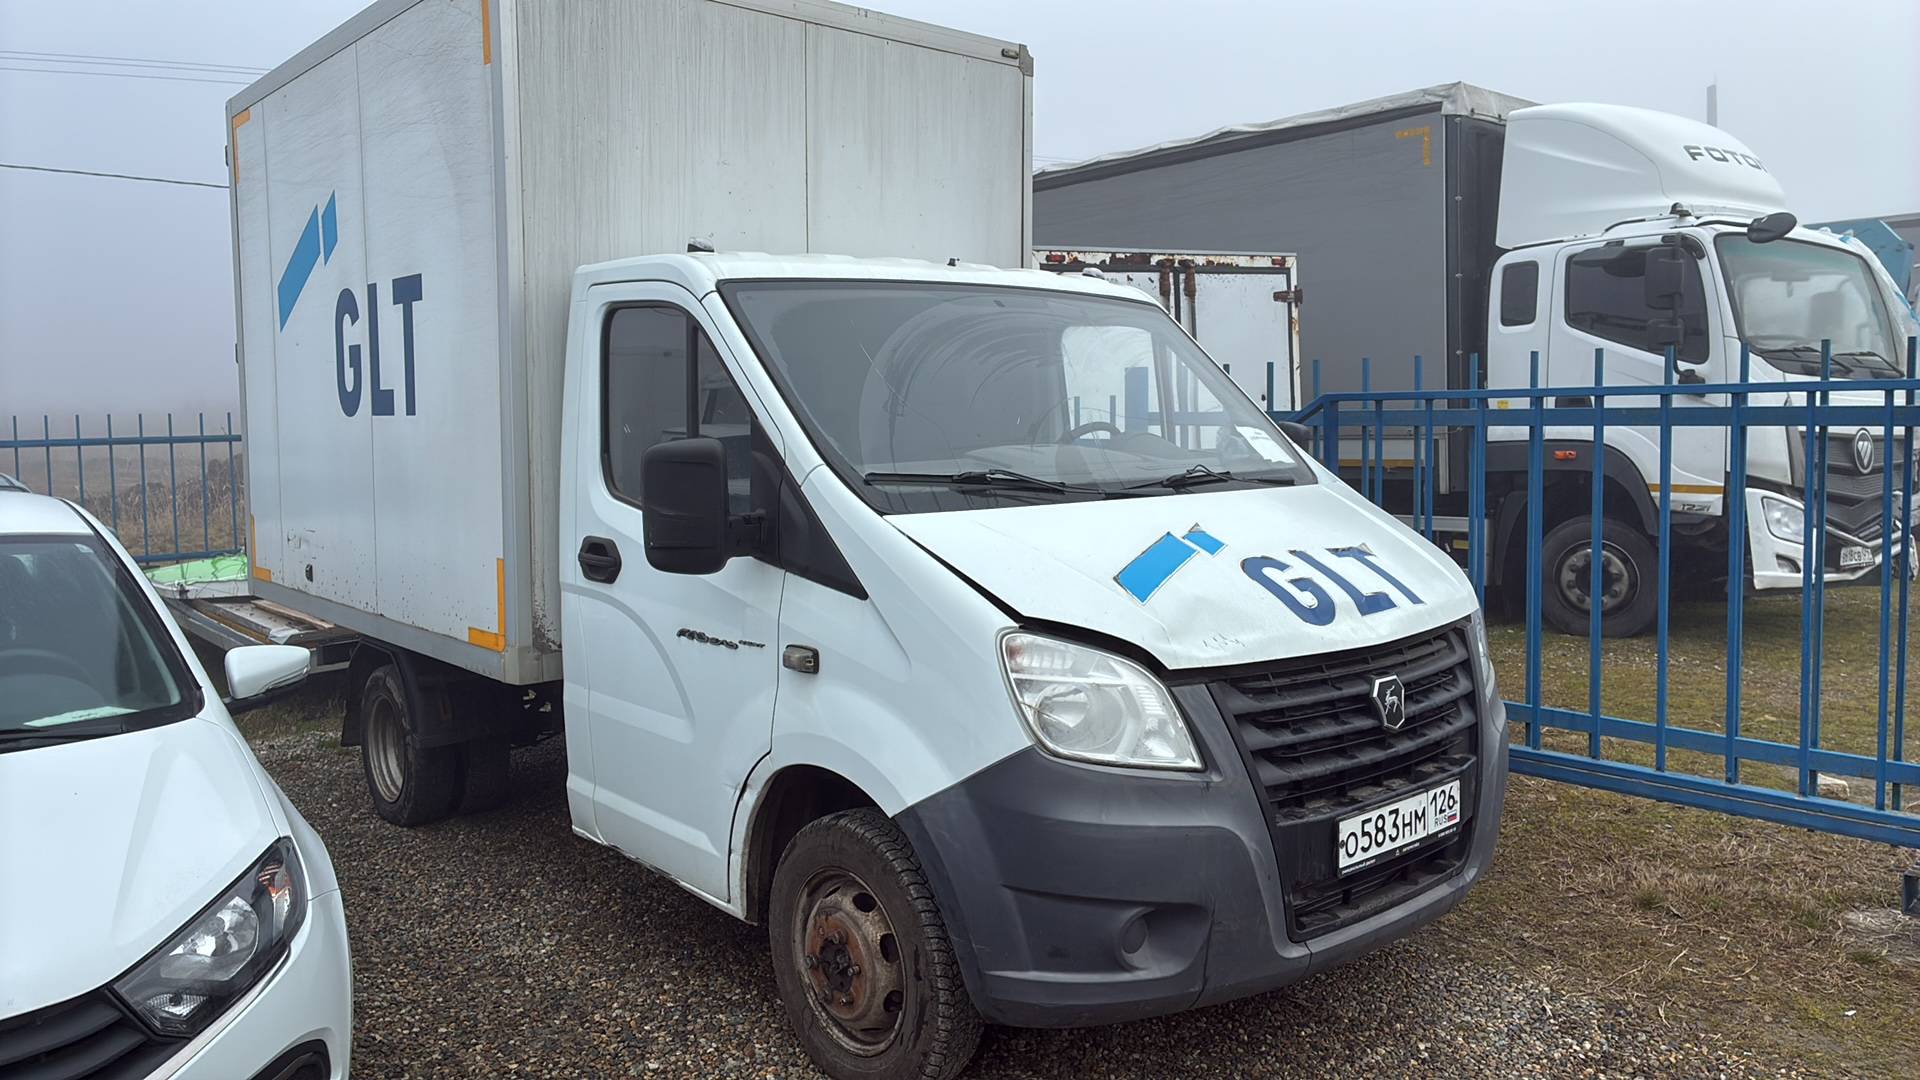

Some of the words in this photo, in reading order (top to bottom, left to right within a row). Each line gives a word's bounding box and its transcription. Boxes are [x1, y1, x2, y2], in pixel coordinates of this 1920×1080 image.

[335, 273, 423, 417] GLT
[1240, 542, 1426, 626] GLT
[1430, 787, 1457, 817] 126
[1434, 815, 1448, 827] RUS
